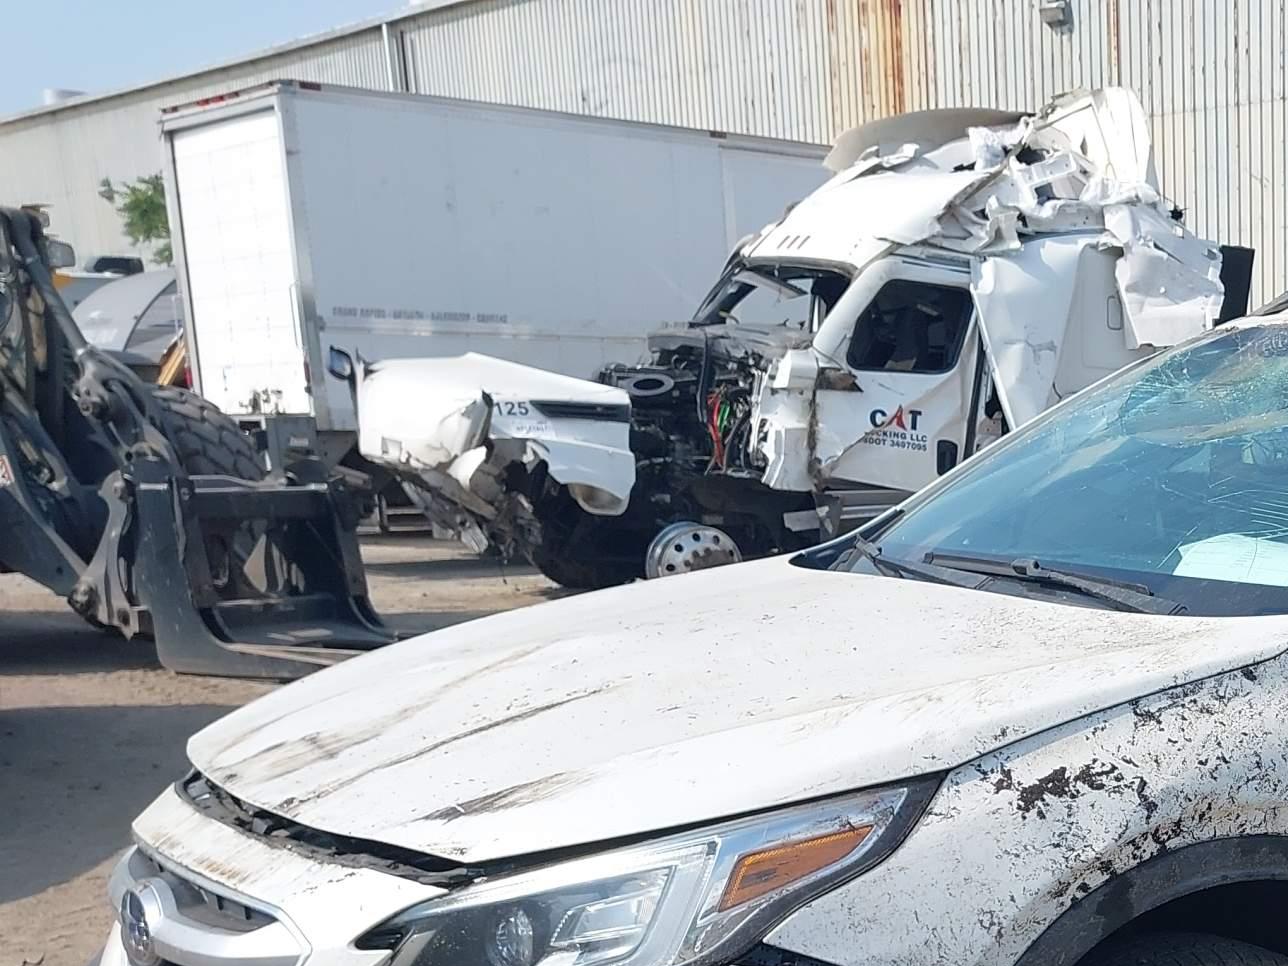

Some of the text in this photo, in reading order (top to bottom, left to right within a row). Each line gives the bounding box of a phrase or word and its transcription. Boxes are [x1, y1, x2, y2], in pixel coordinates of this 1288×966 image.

[495, 401, 529, 416] 125
[870, 404, 922, 431] CAT
[910, 434, 928, 443] LLC
